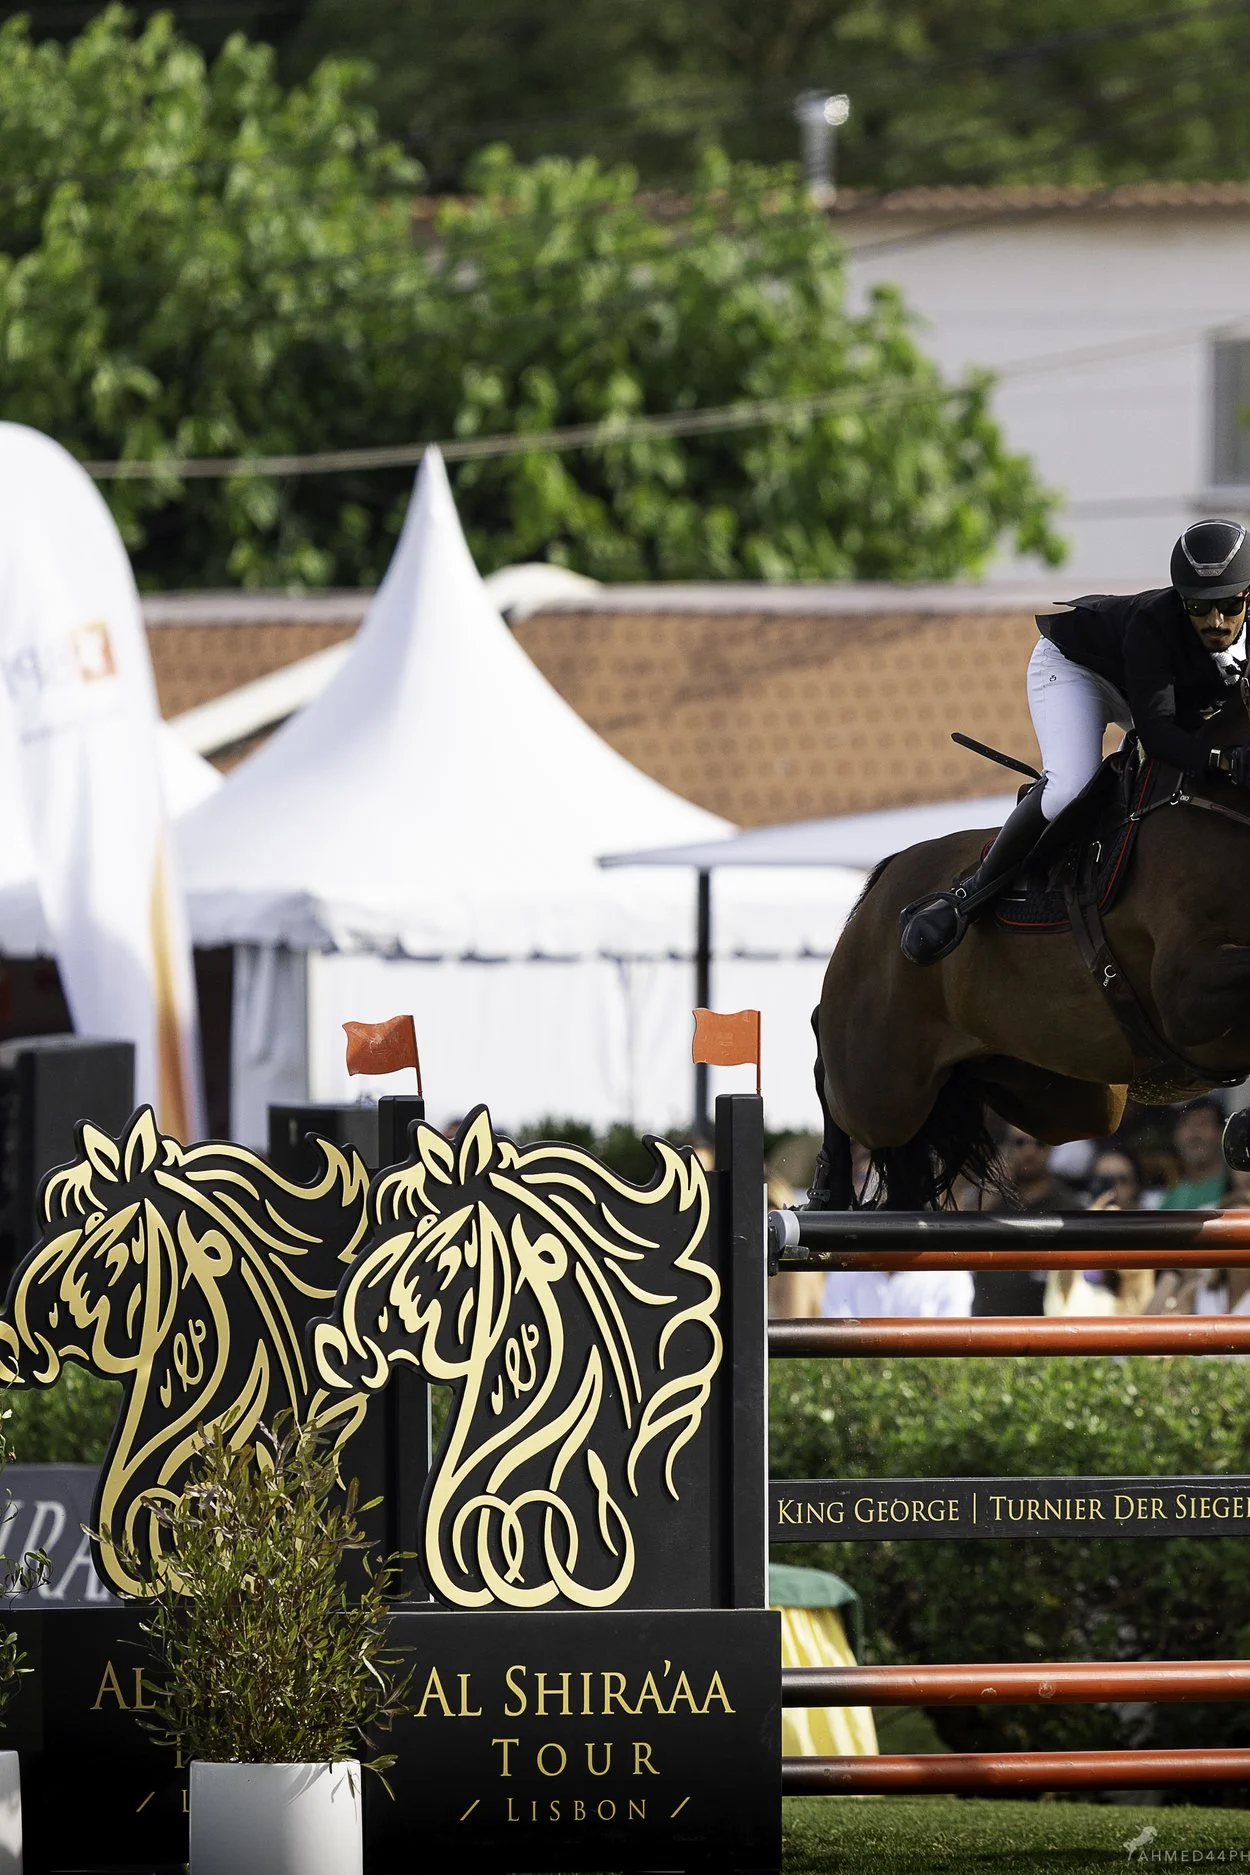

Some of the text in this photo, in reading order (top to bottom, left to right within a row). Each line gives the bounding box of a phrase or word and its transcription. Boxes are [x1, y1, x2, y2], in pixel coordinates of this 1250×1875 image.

[777, 1500, 844, 1524] KING
[853, 1496, 960, 1524] GEORGE
[990, 1495, 1104, 1522] TURNIER
[1114, 1495, 1168, 1520] DER
[89, 1659, 156, 1711] AL
[415, 1659, 737, 1718] AL SHIRA'AA
[491, 1737, 659, 1777] TOUR
[507, 1796, 647, 1822] LISBON
